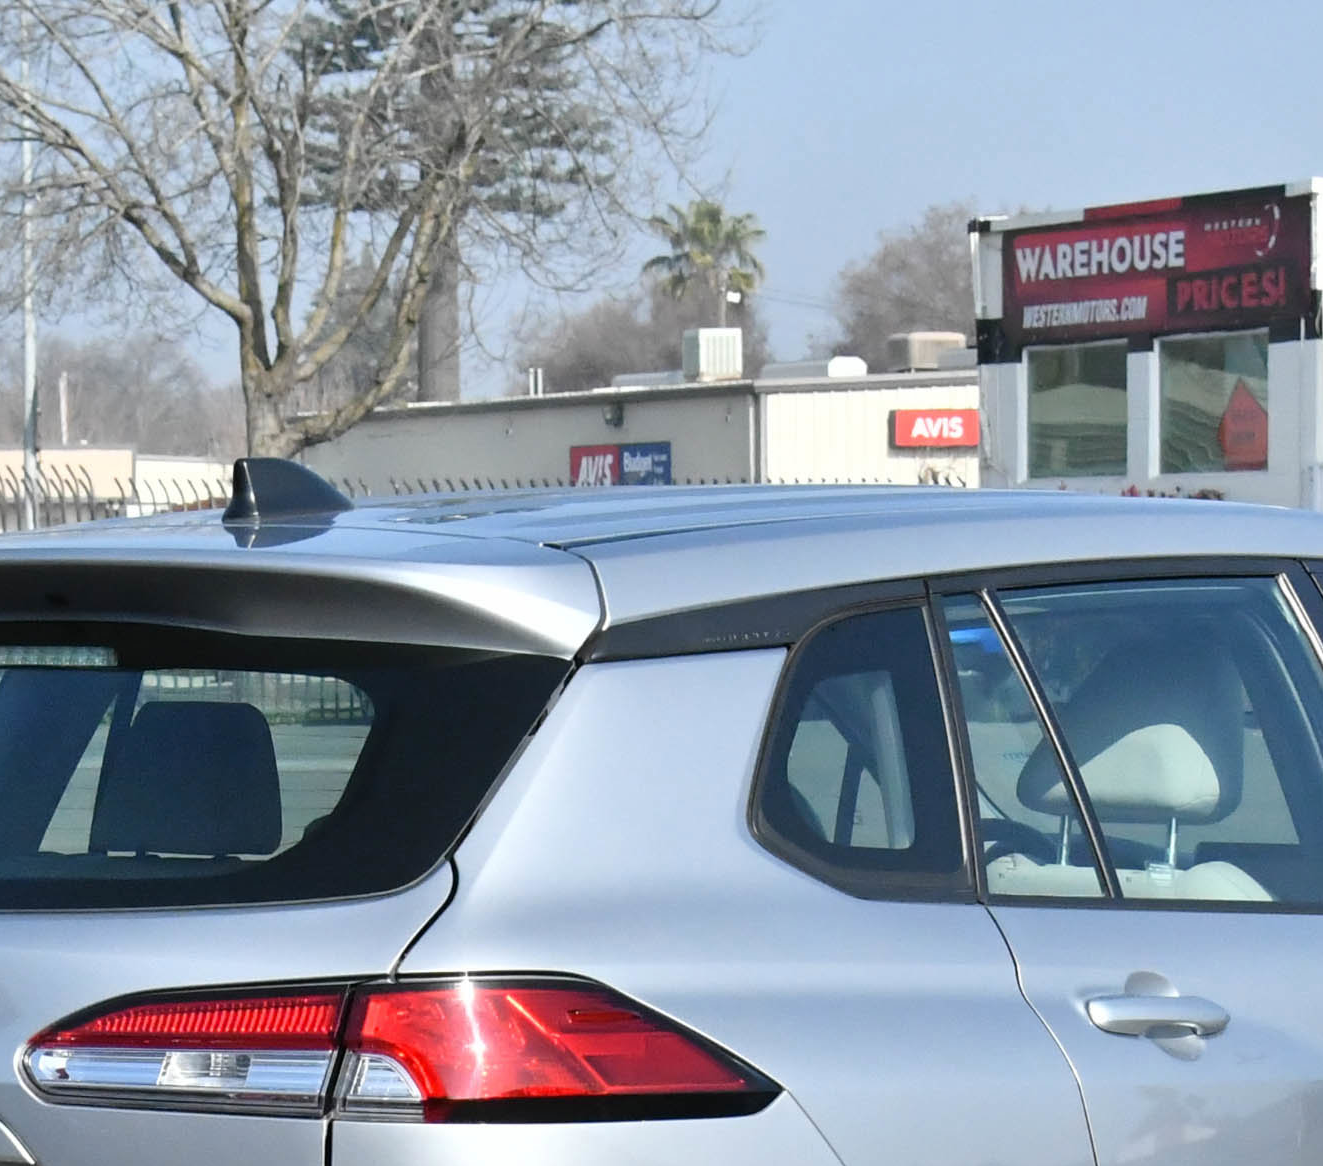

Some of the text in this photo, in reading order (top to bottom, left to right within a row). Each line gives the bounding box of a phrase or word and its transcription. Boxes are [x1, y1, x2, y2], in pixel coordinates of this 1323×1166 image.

[1016, 231, 1185, 283] WAREHOUSE
[1179, 269, 1286, 312] PRICES!
[1023, 296, 1147, 328] WESTERNMOTORS.COM
[911, 417, 964, 438] AVIS
[578, 454, 614, 487] AVIS
